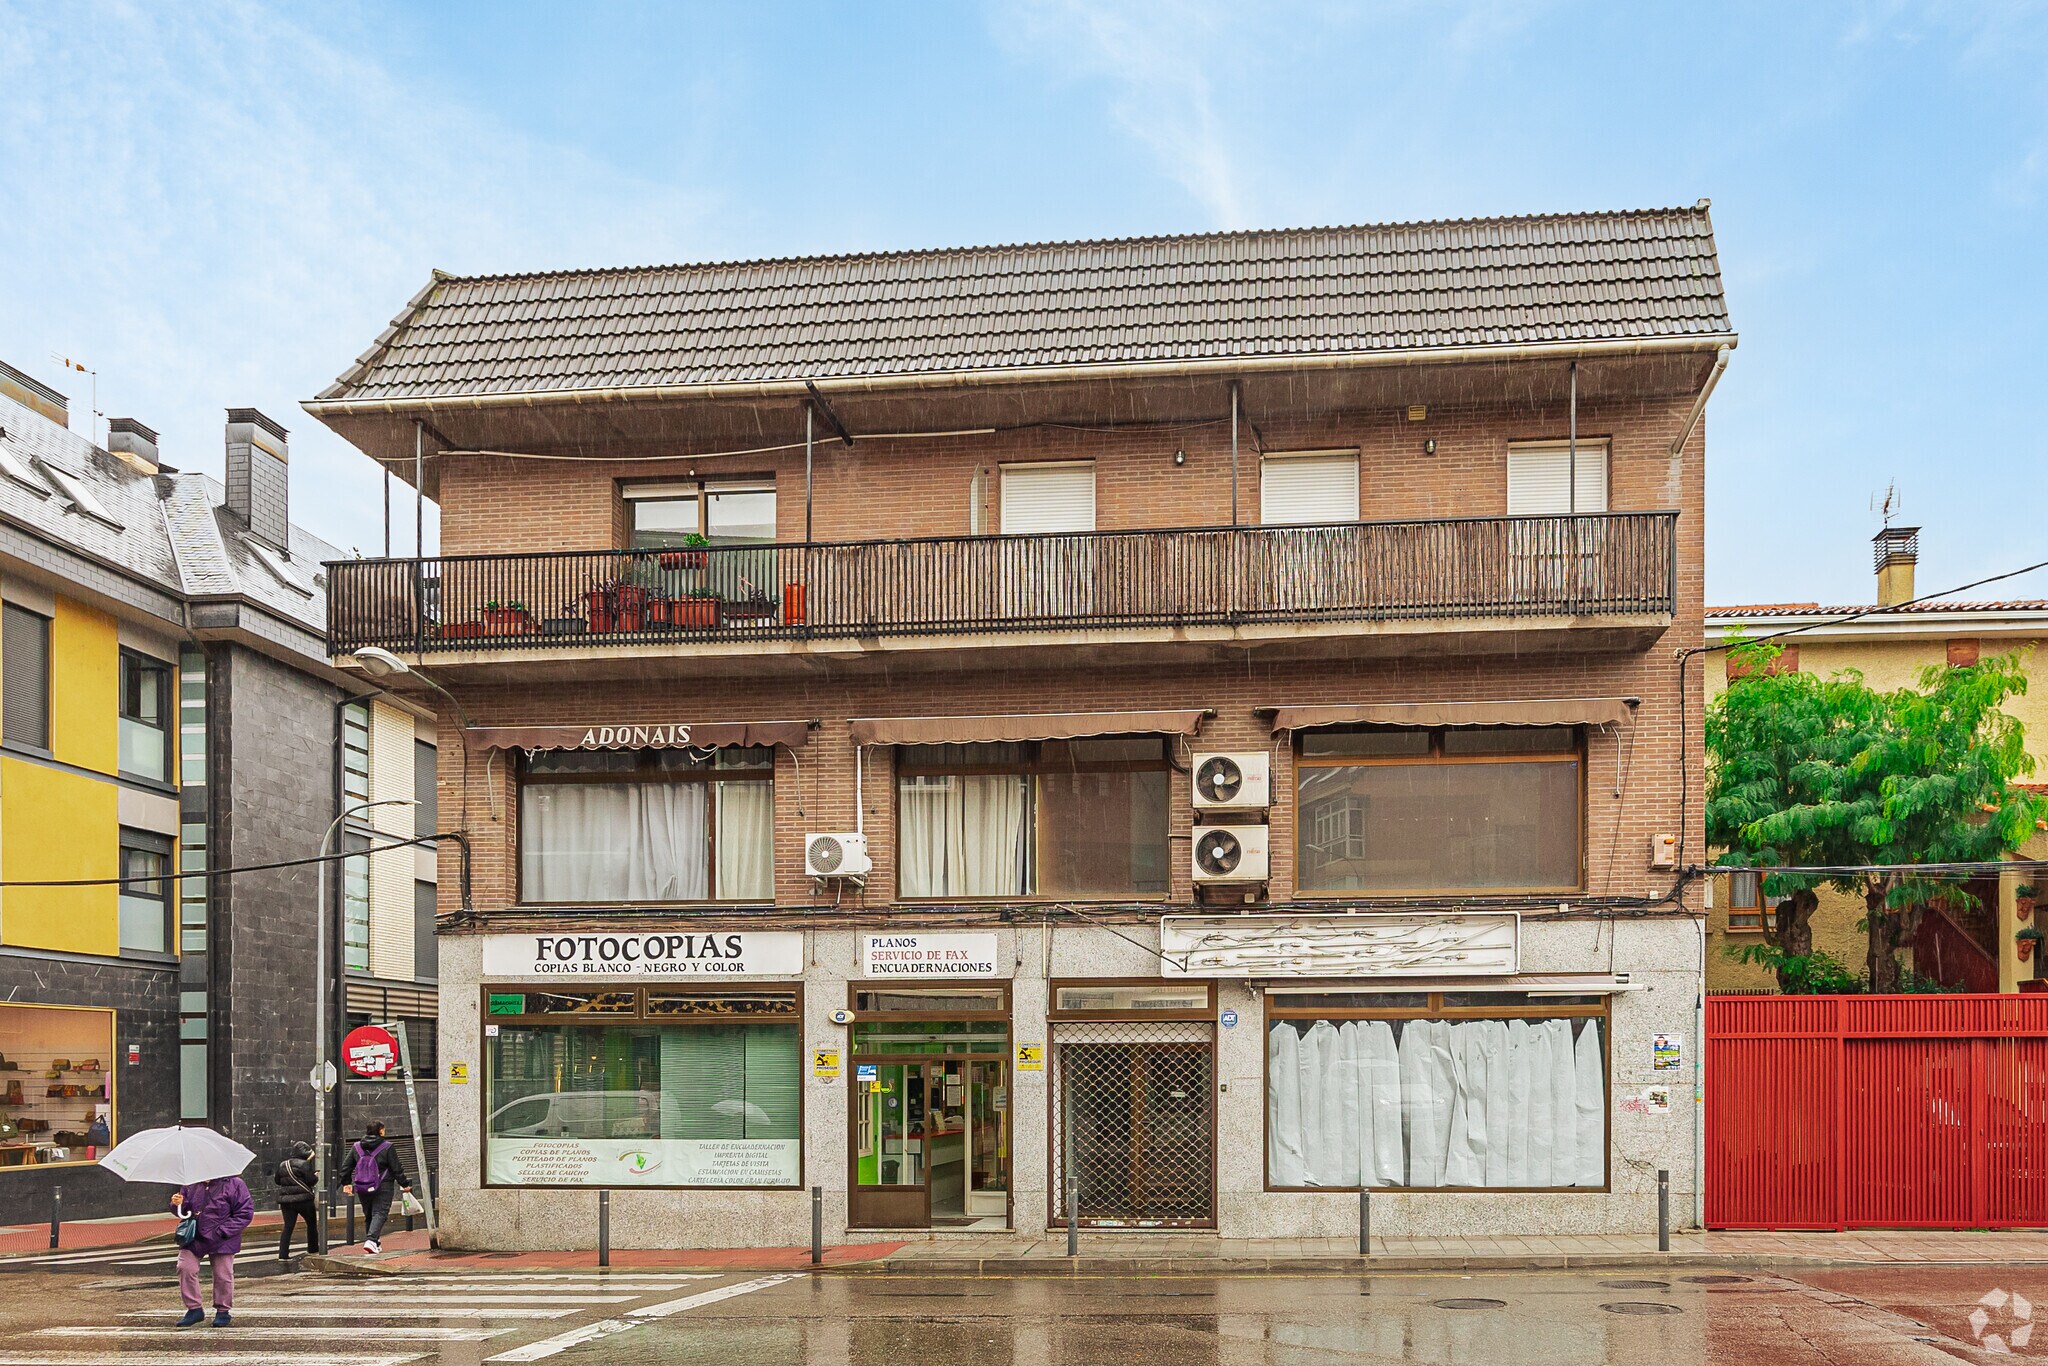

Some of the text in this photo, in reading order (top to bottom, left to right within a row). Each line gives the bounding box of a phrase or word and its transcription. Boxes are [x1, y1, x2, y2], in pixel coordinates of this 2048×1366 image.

[580, 726, 691, 744] ADONAIS
[536, 934, 742, 962] FOTOCOPIAS
[872, 938, 916, 948] PLANOS
[872, 950, 968, 960] SERVICIO DE FAX
[534, 964, 578, 972] COPIAS
[582, 964, 632, 972] BLANCO
[644, 962, 686, 972] NEGRO
[692, 962, 700, 972] Y
[704, 962, 744, 972] COLOR
[872, 962, 992, 974] ENCUADERNACIONES
